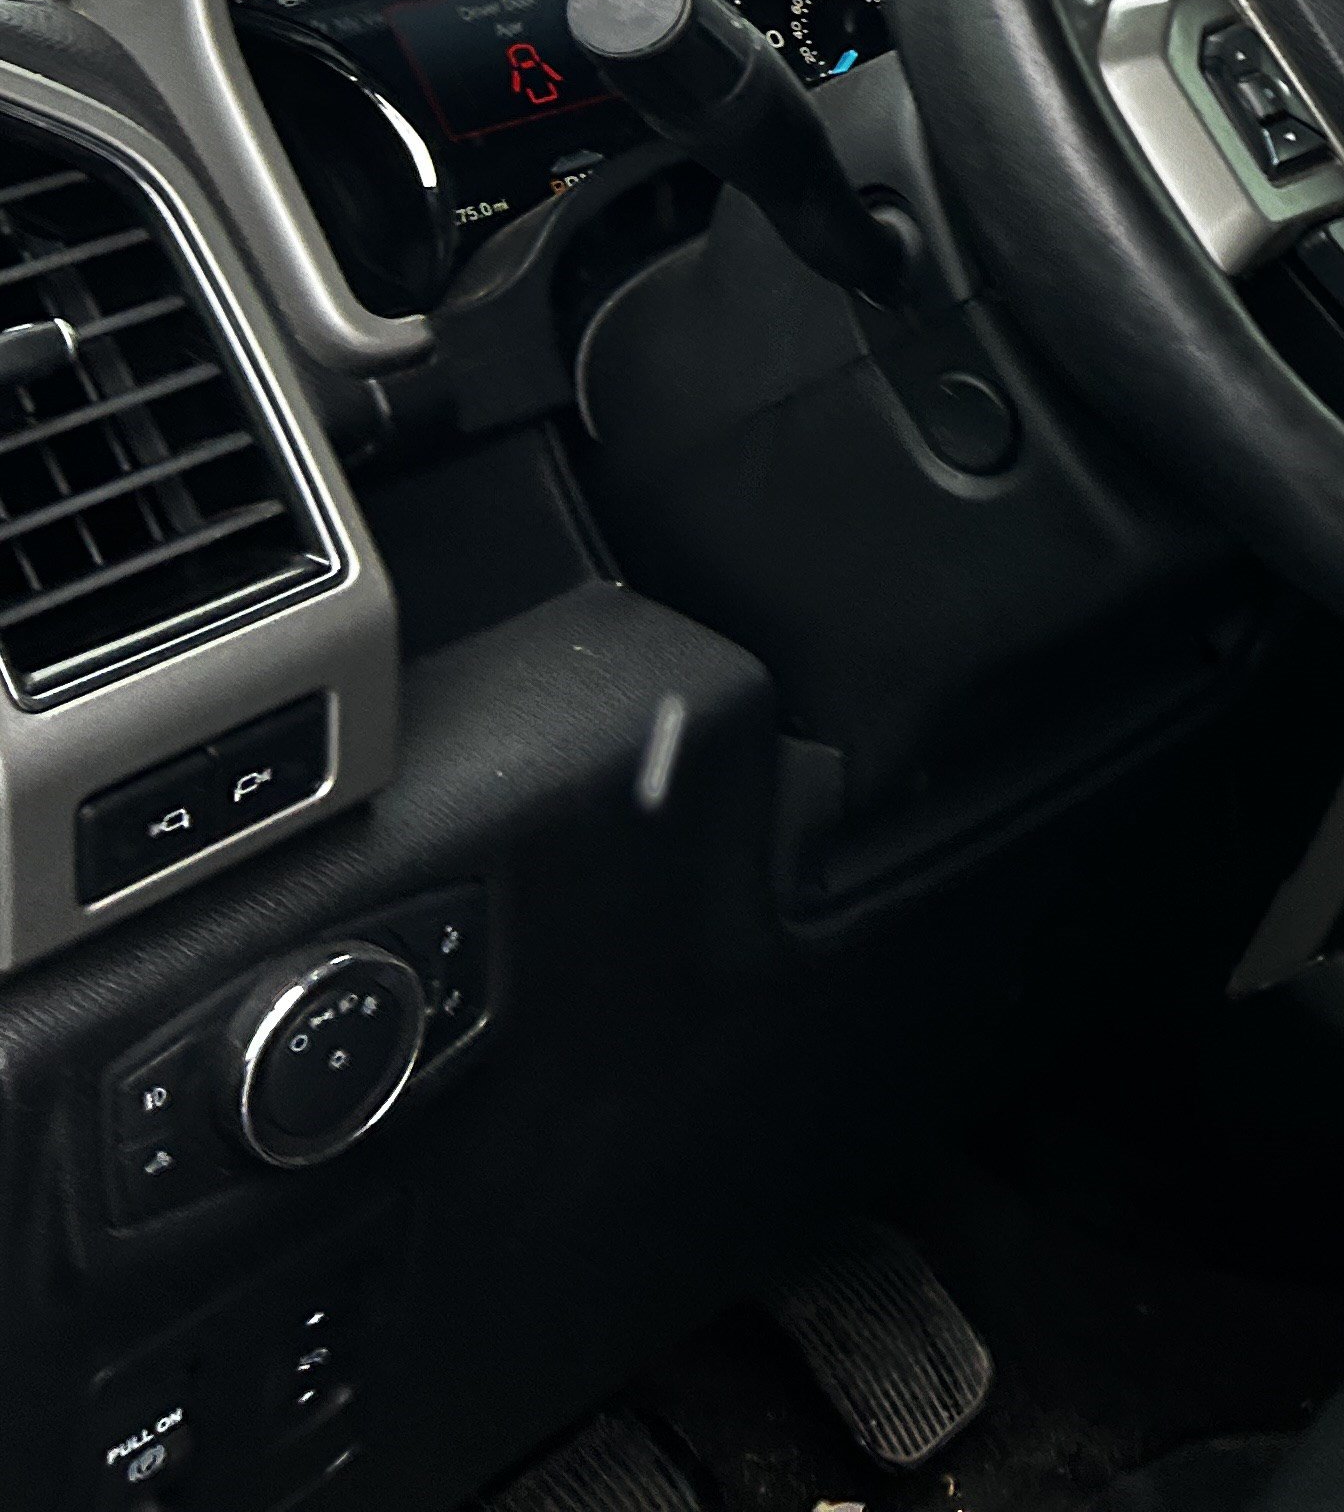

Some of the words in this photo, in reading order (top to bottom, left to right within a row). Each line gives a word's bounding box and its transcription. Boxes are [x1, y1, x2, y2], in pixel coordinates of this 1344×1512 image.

[766, 30, 784, 49] 0
[790, 21, 803, 39] 40
[106, 1429, 155, 1465] PULL
[156, 1407, 183, 1433] ON
